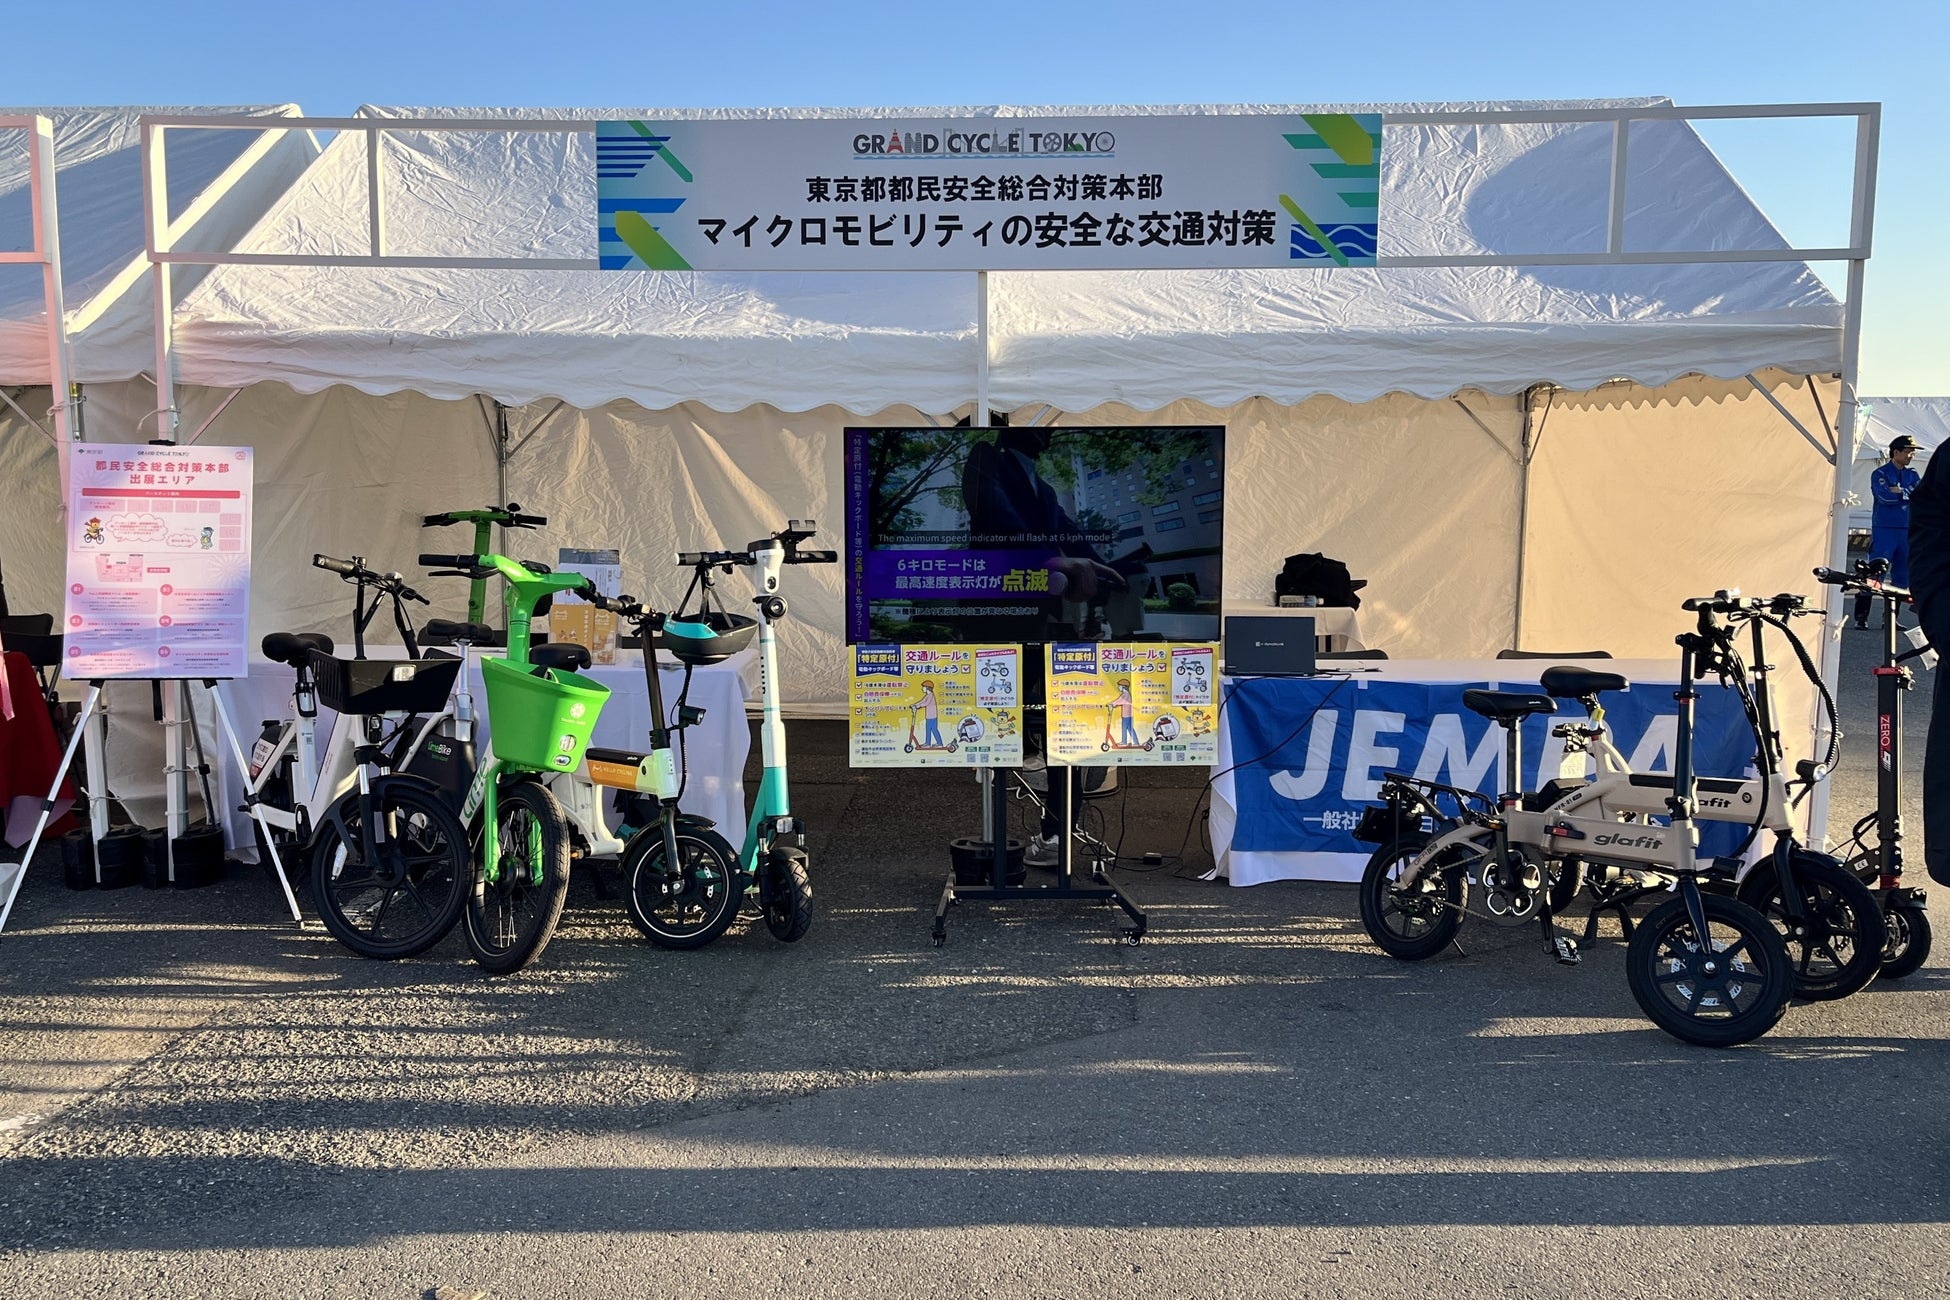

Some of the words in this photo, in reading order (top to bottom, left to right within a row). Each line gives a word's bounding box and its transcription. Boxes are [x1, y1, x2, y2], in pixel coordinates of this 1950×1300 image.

[853, 129, 939, 154] GRAND
[947, 129, 1020, 153] CYCLE
[1029, 131, 1116, 153] TOKYO
[805, 174, 1164, 203] 東京都都民安全総合対策本部
[698, 208, 1277, 249] マイクロモビリティの安全な交通対策
[96, 460, 230, 473] 都民安全総合対策本部
[130, 474, 195, 485] 出展エリア
[878, 533, 895, 543] The
[896, 535, 940, 543] maximum
[941, 533, 967, 545] speed
[969, 533, 1007, 543] indicator
[1009, 533, 1024, 543] will
[1026, 533, 1047, 543] flash
[1049, 534, 1058, 543] at
[1060, 534, 1065, 543] 6
[1066, 533, 1083, 545] kph
[1085, 533, 1110, 543] mode
[897, 558, 986, 571] 6キロモードは
[895, 568, 1049, 592] 最高速度表示灯が点滅
[905, 650, 970, 661] 交通ルールを
[1101, 649, 1166, 660] 交通ルールを
[906, 664, 959, 674] 守りましょう
[1101, 663, 1155, 673] 守りましょう
[1880, 716, 1890, 747] ZERO
[1698, 797, 1732, 809] afit
[1303, 810, 1363, 830] 一般社
[1593, 833, 1664, 850] glafit
